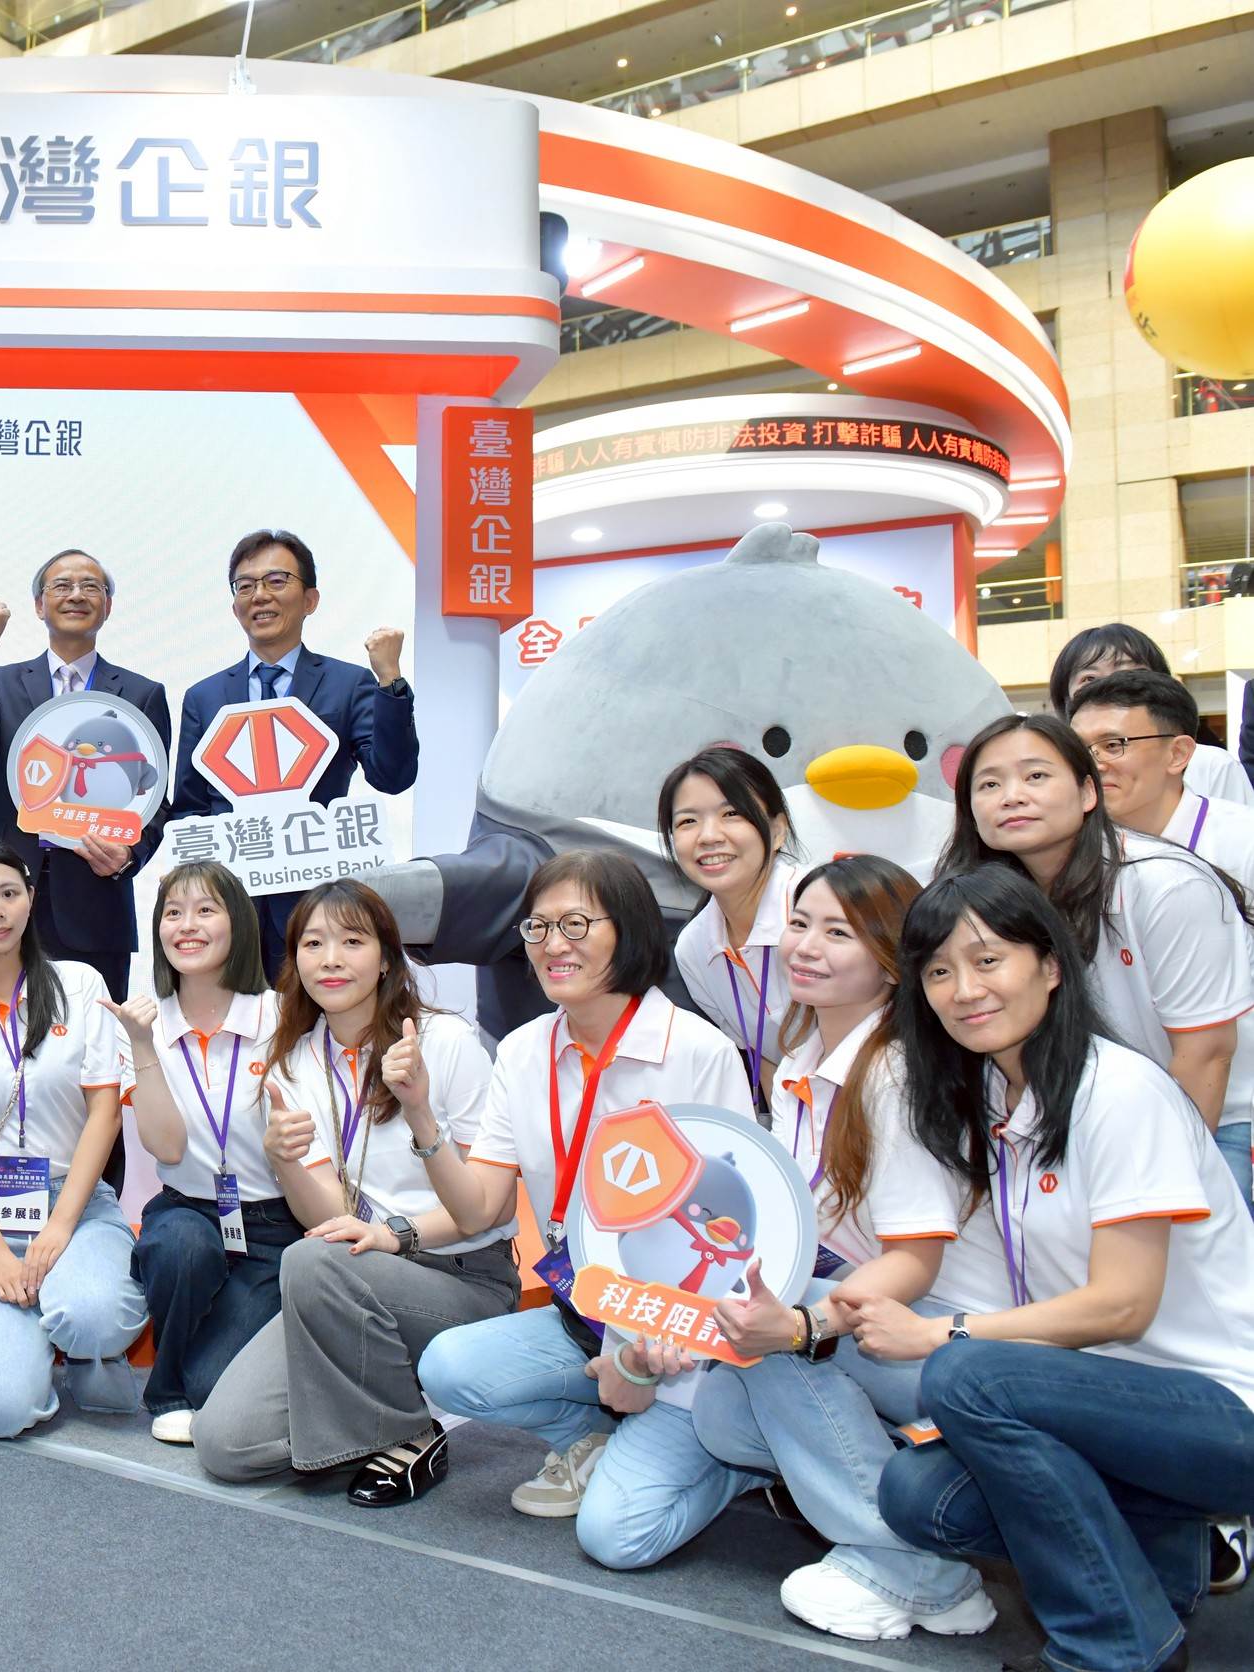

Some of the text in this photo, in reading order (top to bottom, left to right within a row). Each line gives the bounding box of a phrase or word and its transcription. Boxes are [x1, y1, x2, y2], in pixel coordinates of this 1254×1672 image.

[812, 421, 902, 449] 打擊詐騙
[469, 418, 513, 605] 臺灣企銀
[52, 807, 101, 823] 守護民眾
[88, 823, 136, 840] 財產安全
[171, 802, 384, 866] 臺灣企銀
[249, 864, 333, 888] Business
[0, 1206, 42, 1220] 參展證
[597, 1283, 731, 1348] 科技阻詐
